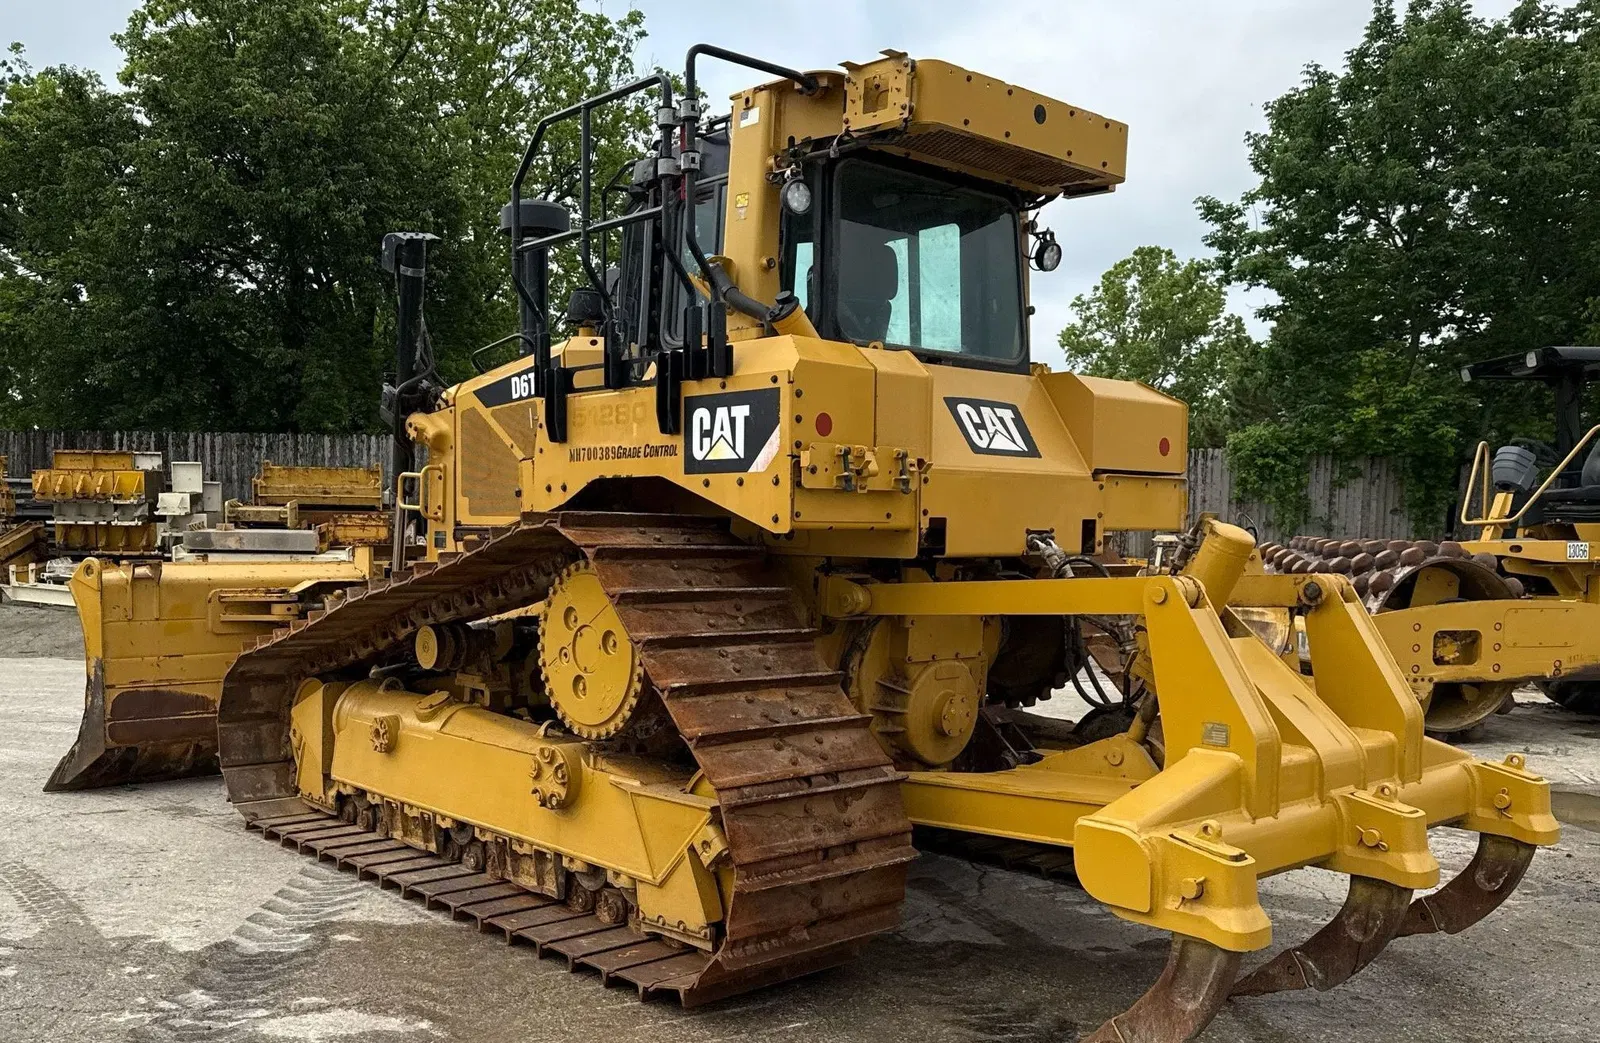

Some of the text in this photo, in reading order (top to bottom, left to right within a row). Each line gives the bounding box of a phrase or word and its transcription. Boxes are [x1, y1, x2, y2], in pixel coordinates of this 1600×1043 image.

[691, 404, 749, 461] CAT
[956, 403, 1029, 452] CAT
[615, 442, 678, 459] GRADE CONTROL
[1568, 543, 1588, 558] 13056
